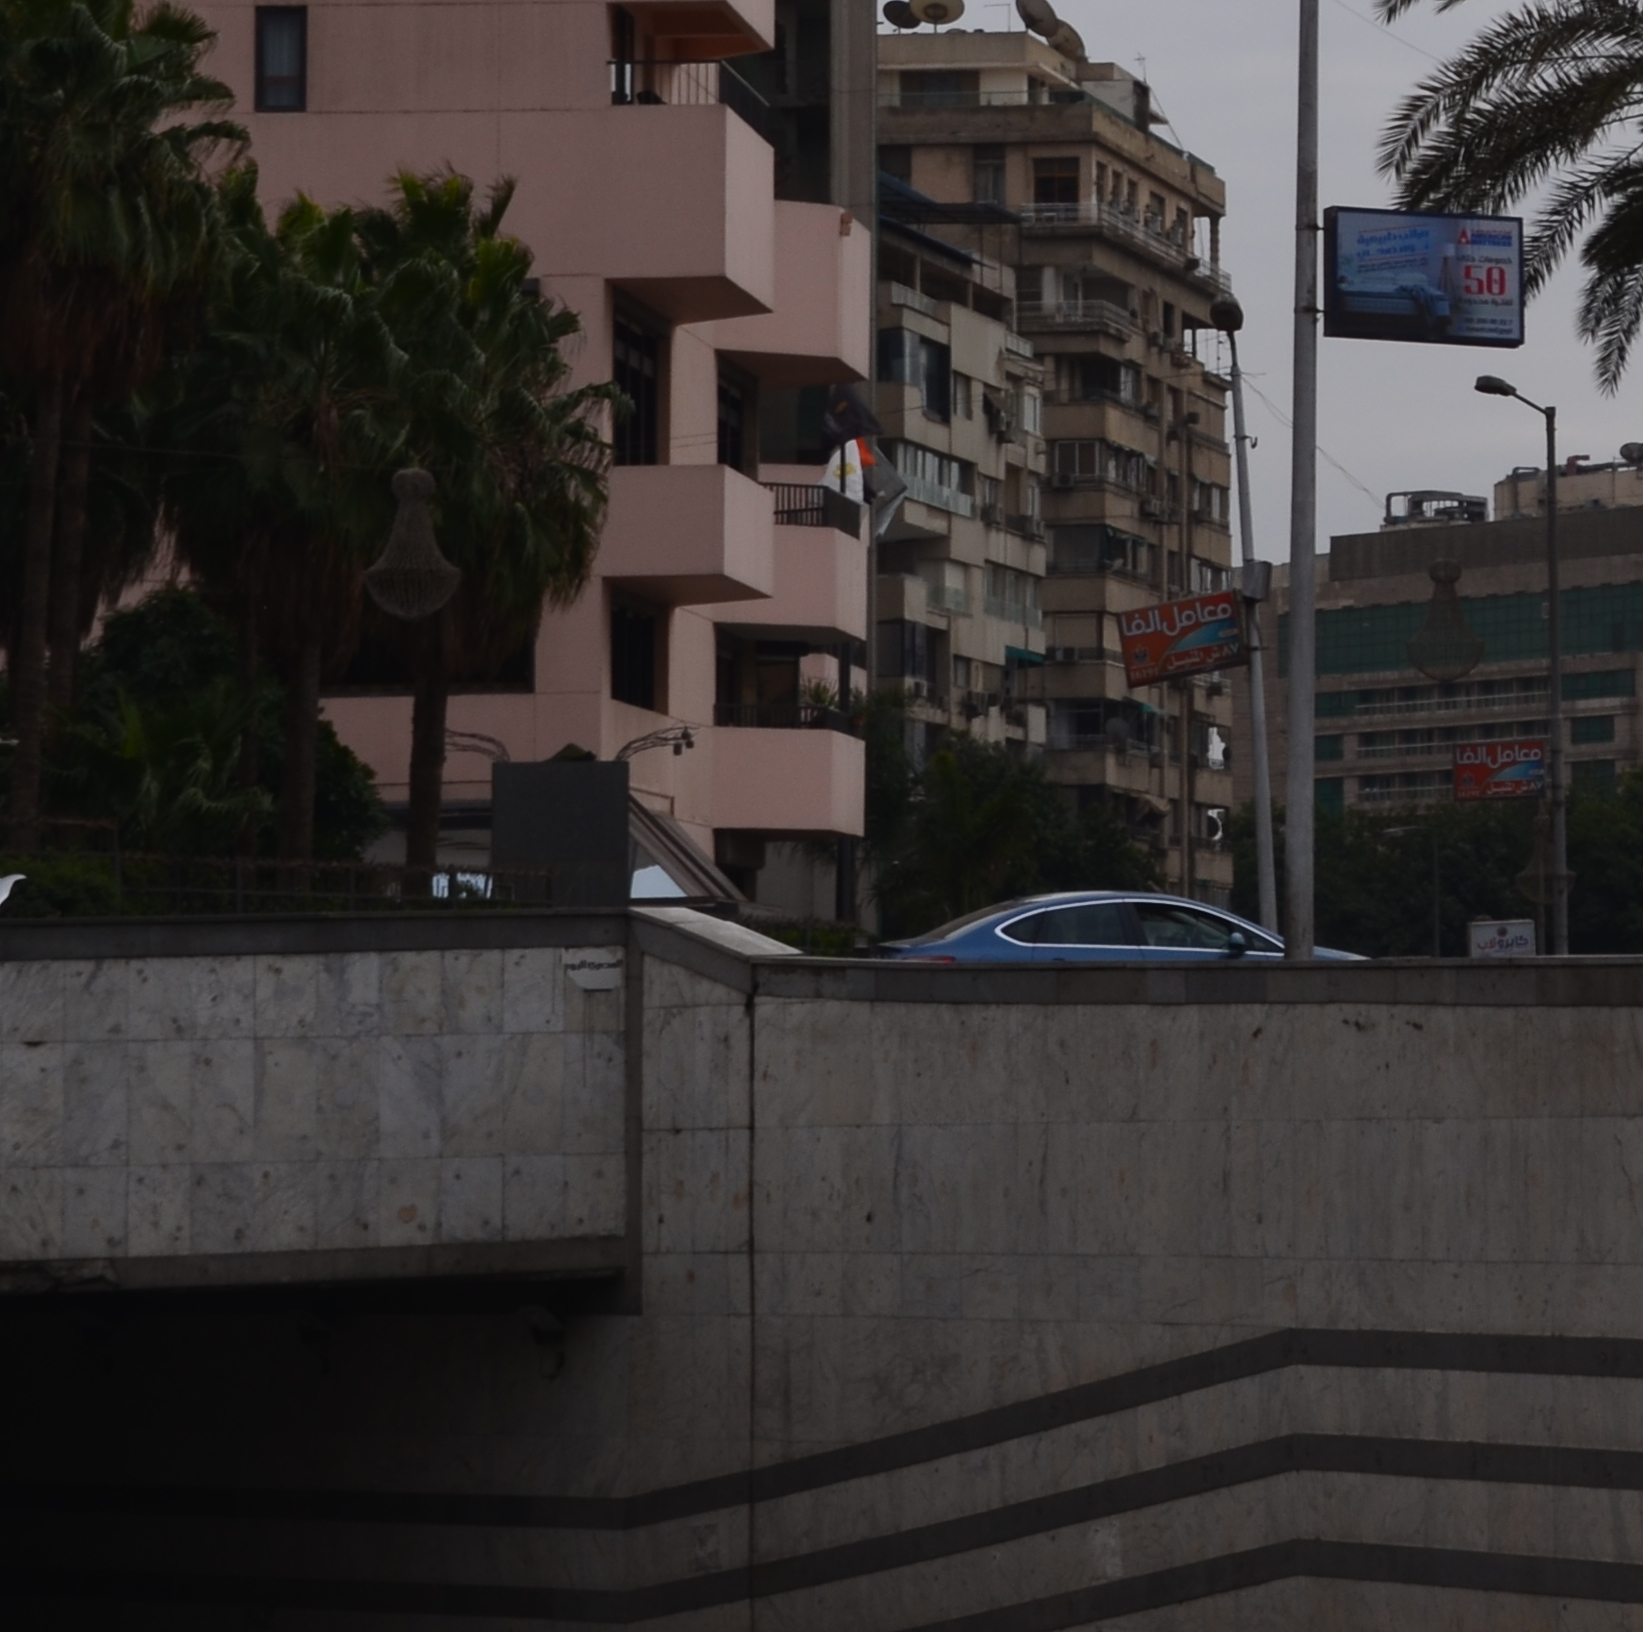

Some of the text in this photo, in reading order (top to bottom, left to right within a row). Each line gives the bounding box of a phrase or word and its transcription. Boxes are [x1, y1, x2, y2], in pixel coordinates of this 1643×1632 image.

[1122, 602, 1232, 637] معامل الفا
[1456, 744, 1542, 769] معامل الفا
